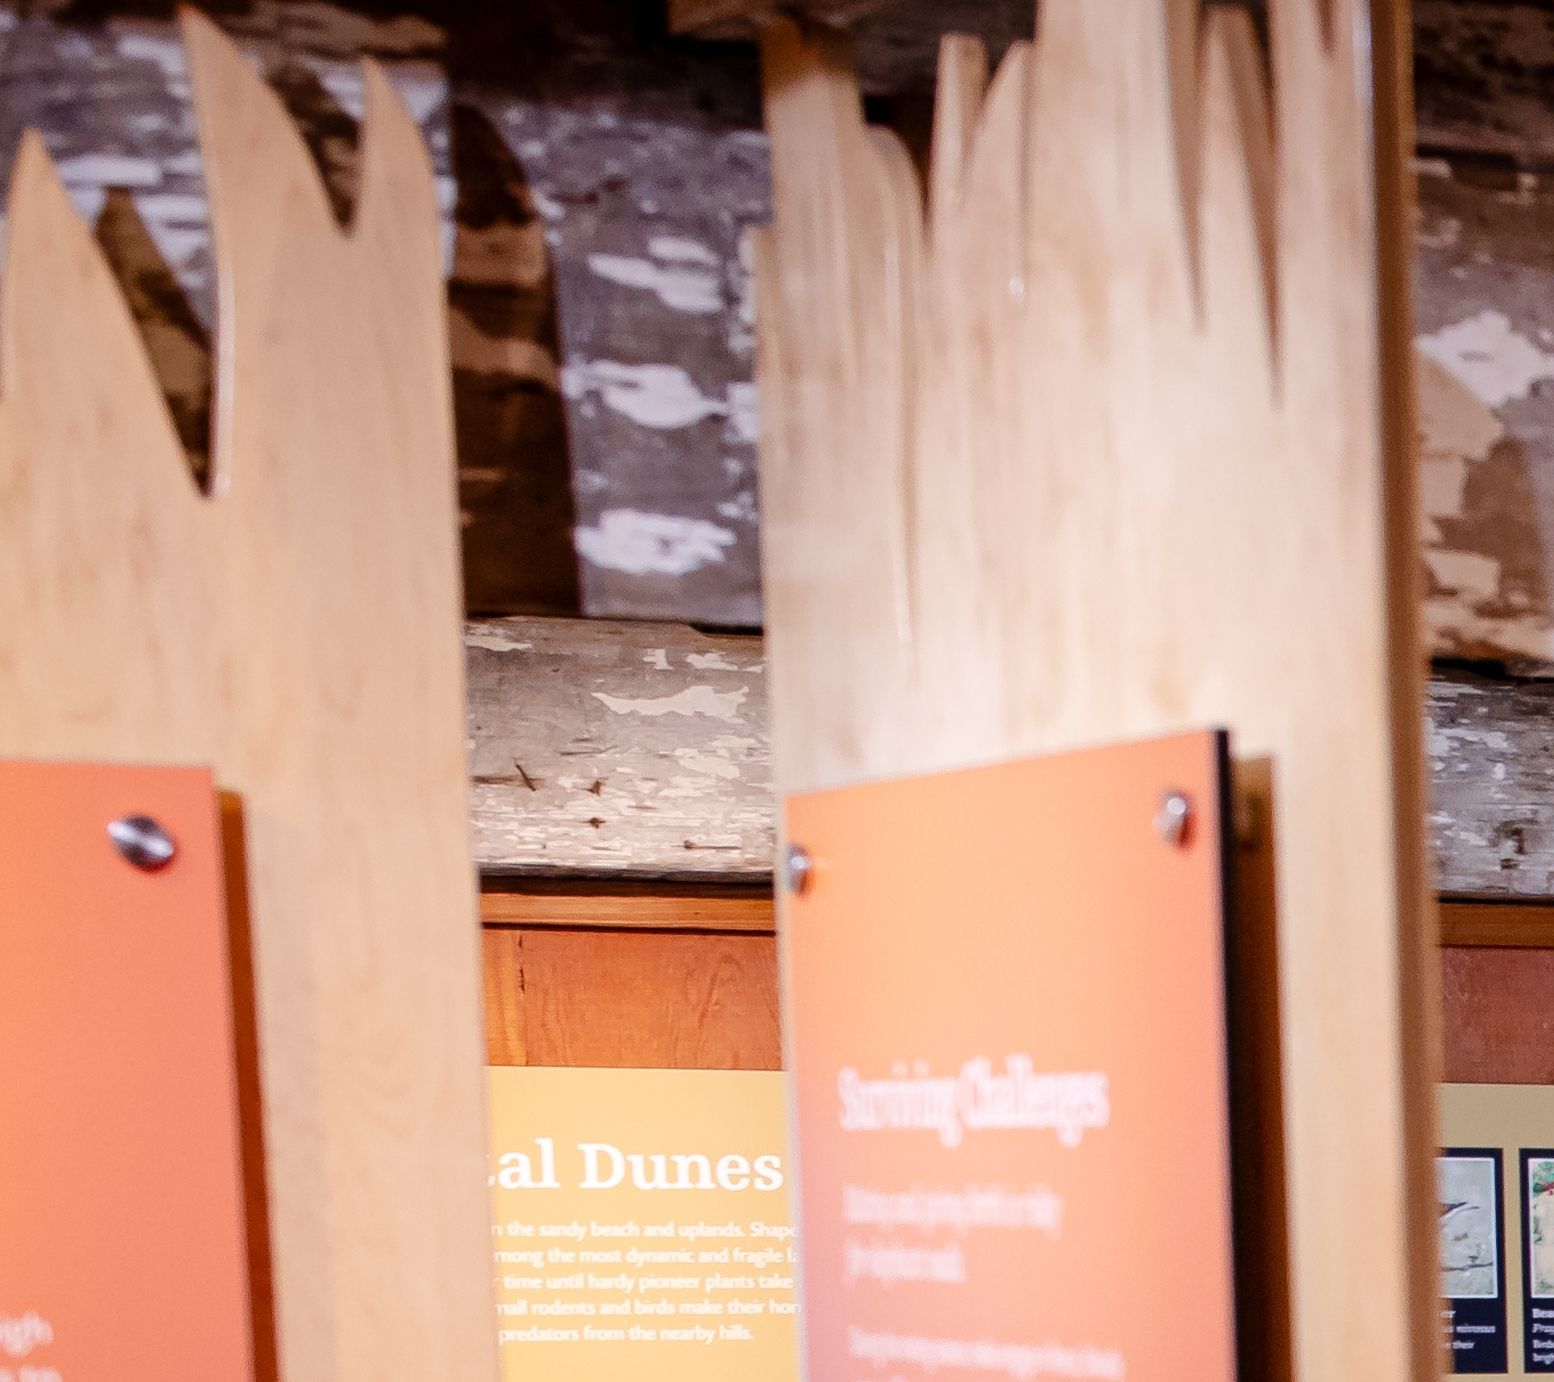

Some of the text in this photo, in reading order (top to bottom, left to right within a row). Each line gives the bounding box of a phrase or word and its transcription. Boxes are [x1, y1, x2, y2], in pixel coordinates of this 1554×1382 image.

[487, 1138, 784, 1191] al Dunes
[505, 1221, 535, 1237] the
[538, 1221, 588, 1242] sandy
[589, 1220, 641, 1237] beach
[643, 1221, 676, 1237] and
[677, 1221, 746, 1241] uplands.
[749, 1221, 798, 1242] Shape
[495, 1251, 544, 1269] mong
[547, 1247, 576, 1264] the
[578, 1250, 622, 1263] most
[624, 1247, 695, 1268] dynamic
[698, 1247, 730, 1263] and
[732, 1247, 784, 1268] fragile
[503, 1273, 796, 1293] time until hardy pioneer plants take
[497, 1299, 528, 1316] mall
[530, 1299, 597, 1315] rodents
[598, 1299, 632, 1315] and
[633, 1298, 677, 1315] birds
[678, 1298, 724, 1315] make
[726, 1299, 766, 1315] their
[498, 1324, 754, 1345] predators from the nearby hills.
